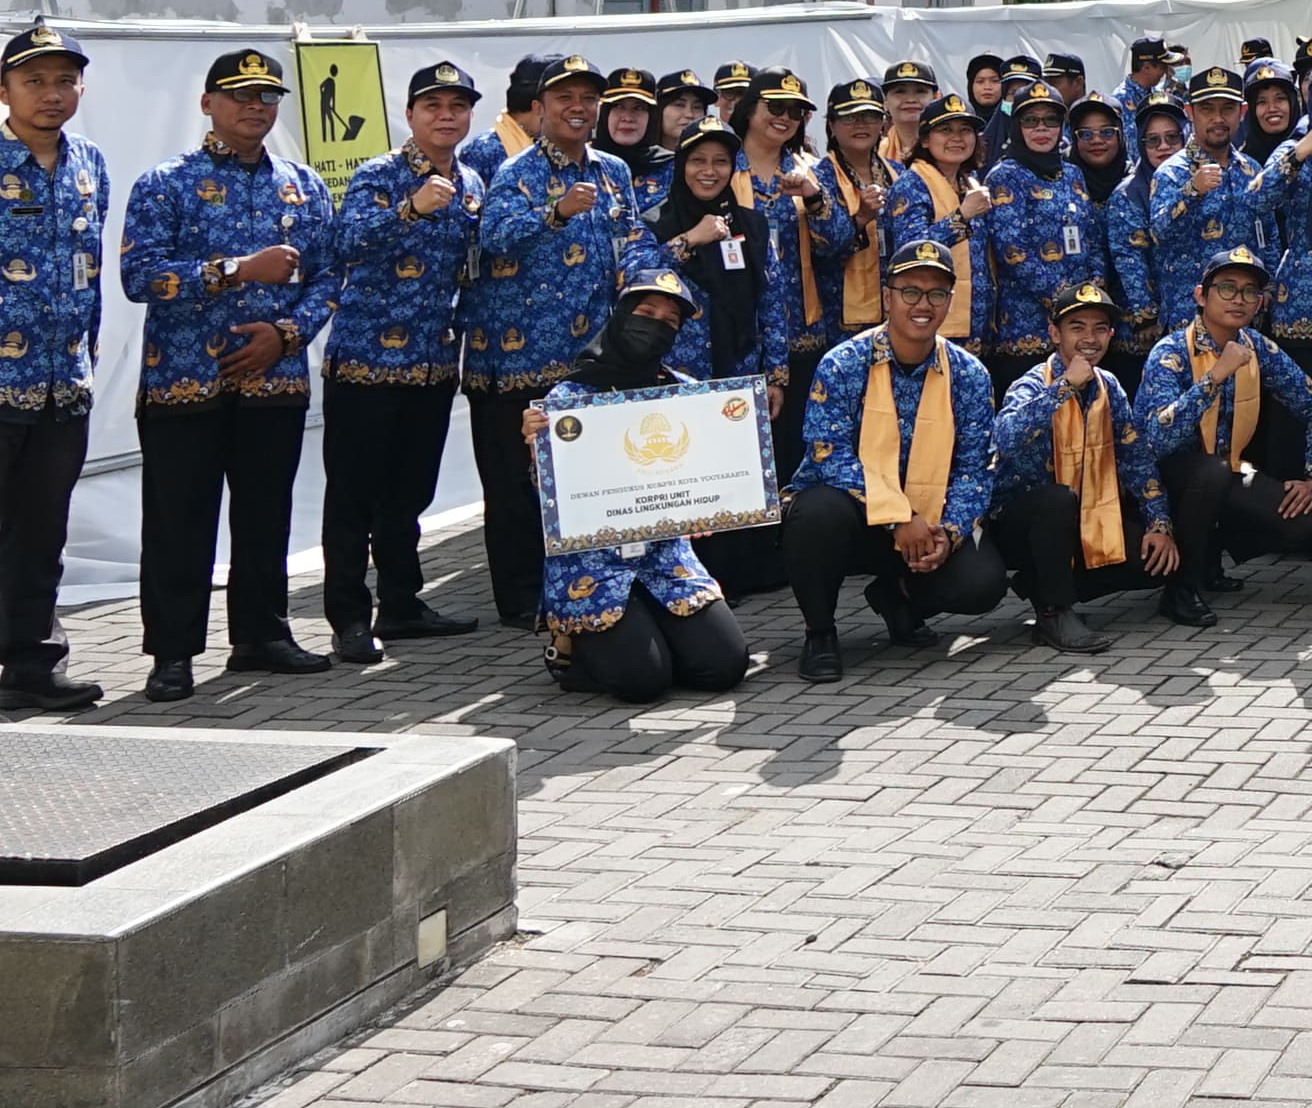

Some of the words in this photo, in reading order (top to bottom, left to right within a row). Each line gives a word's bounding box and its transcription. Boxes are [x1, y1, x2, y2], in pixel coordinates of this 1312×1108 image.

[314, 159, 336, 173] HATI
[570, 490, 600, 500] DEWAN
[678, 477, 698, 487] KOTA
[700, 470, 750, 483] YOGYAKARTA
[606, 508, 634, 517] DINAS
[635, 499, 693, 514] LINGKUNGAN
[694, 495, 721, 505] HIDUP
[635, 492, 668, 505] KORPRI
[670, 490, 691, 501] UNIT
